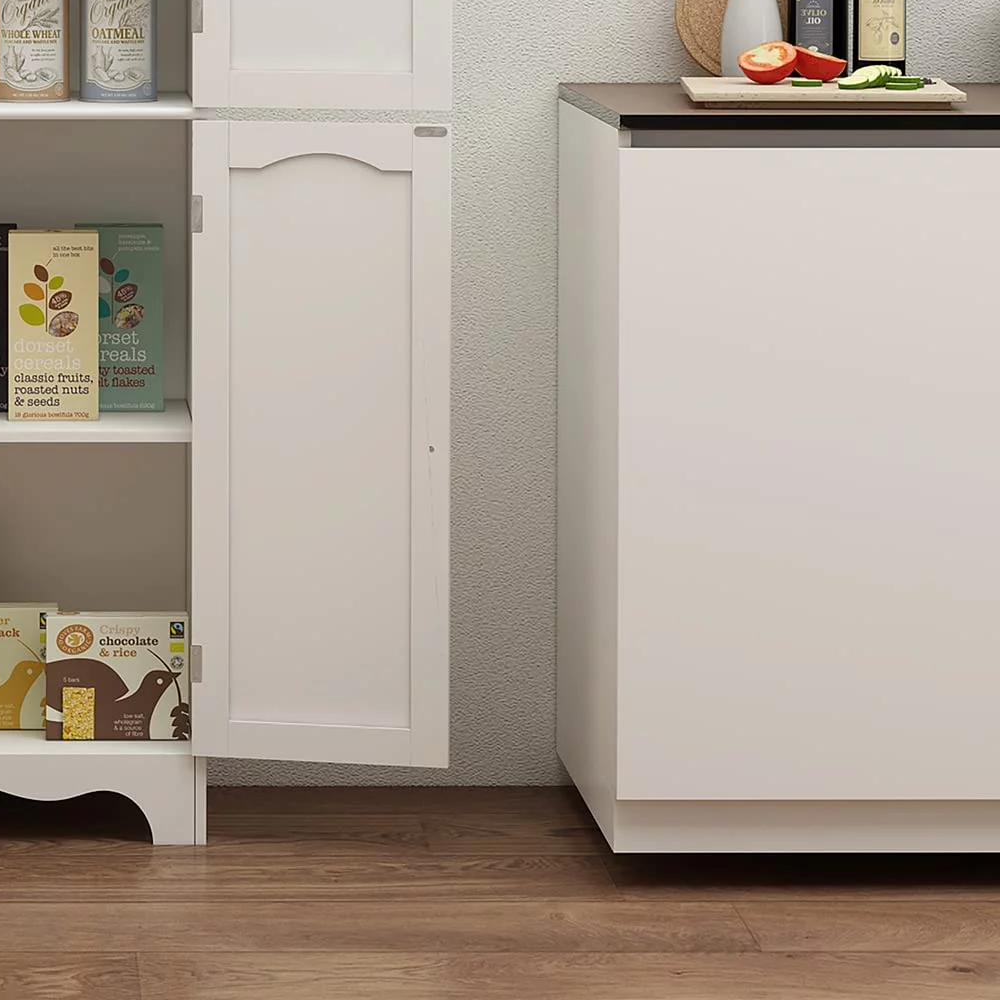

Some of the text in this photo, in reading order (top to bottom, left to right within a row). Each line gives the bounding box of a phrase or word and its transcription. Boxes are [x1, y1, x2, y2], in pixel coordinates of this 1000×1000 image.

[1, 30, 61, 39] WHOLE WHEAT
[92, 28, 145, 39] OATMEAL
[14, 339, 74, 353] dorset
[100, 347, 147, 362] reals
[14, 356, 81, 370] cereals
[113, 365, 155, 375] toasted
[14, 373, 94, 384] classic fruits,
[112, 377, 145, 387] flakes
[14, 385, 89, 395] roasted nuts
[14, 398, 60, 407] & seeds
[99, 625, 141, 636] Crispy
[99, 636, 159, 646] chocolate
[99, 648, 137, 657] & rice
